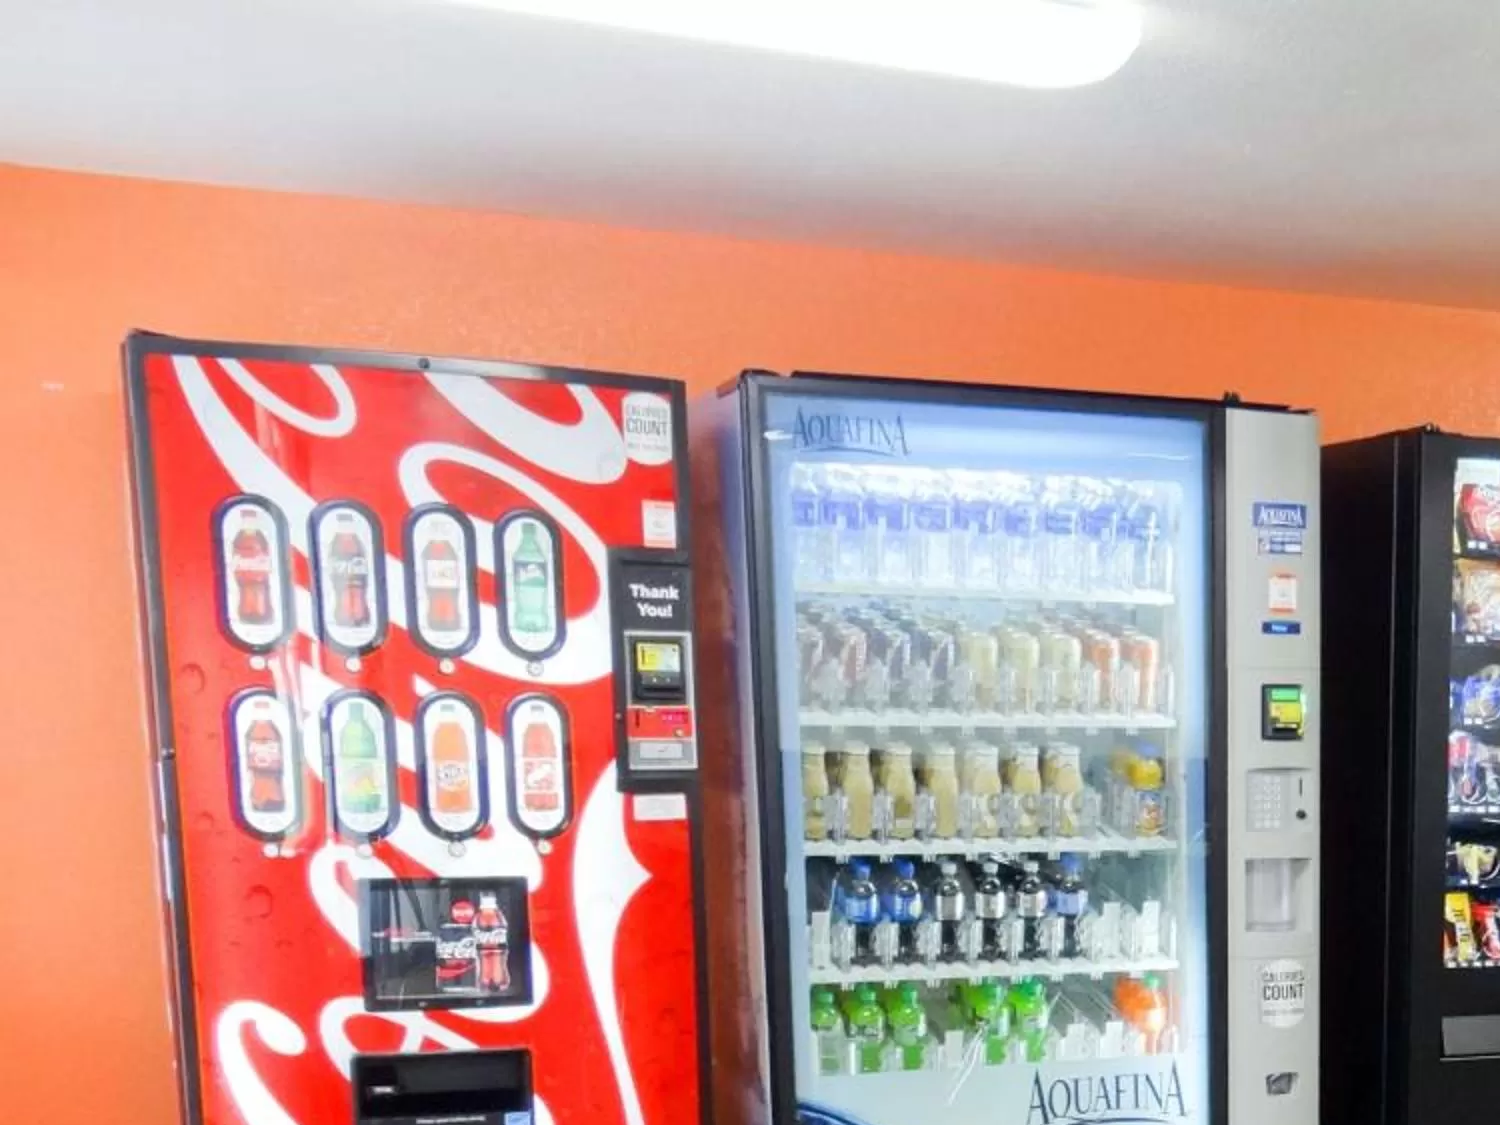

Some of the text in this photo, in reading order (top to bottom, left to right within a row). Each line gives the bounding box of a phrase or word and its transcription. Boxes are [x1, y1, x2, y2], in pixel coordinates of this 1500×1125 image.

[625, 417, 671, 436] COUNT
[791, 403, 913, 457] AQUAFINA
[628, 582, 680, 600] Thank
[636, 601, 673, 618] You!
[1262, 983, 1304, 1001] COUNT
